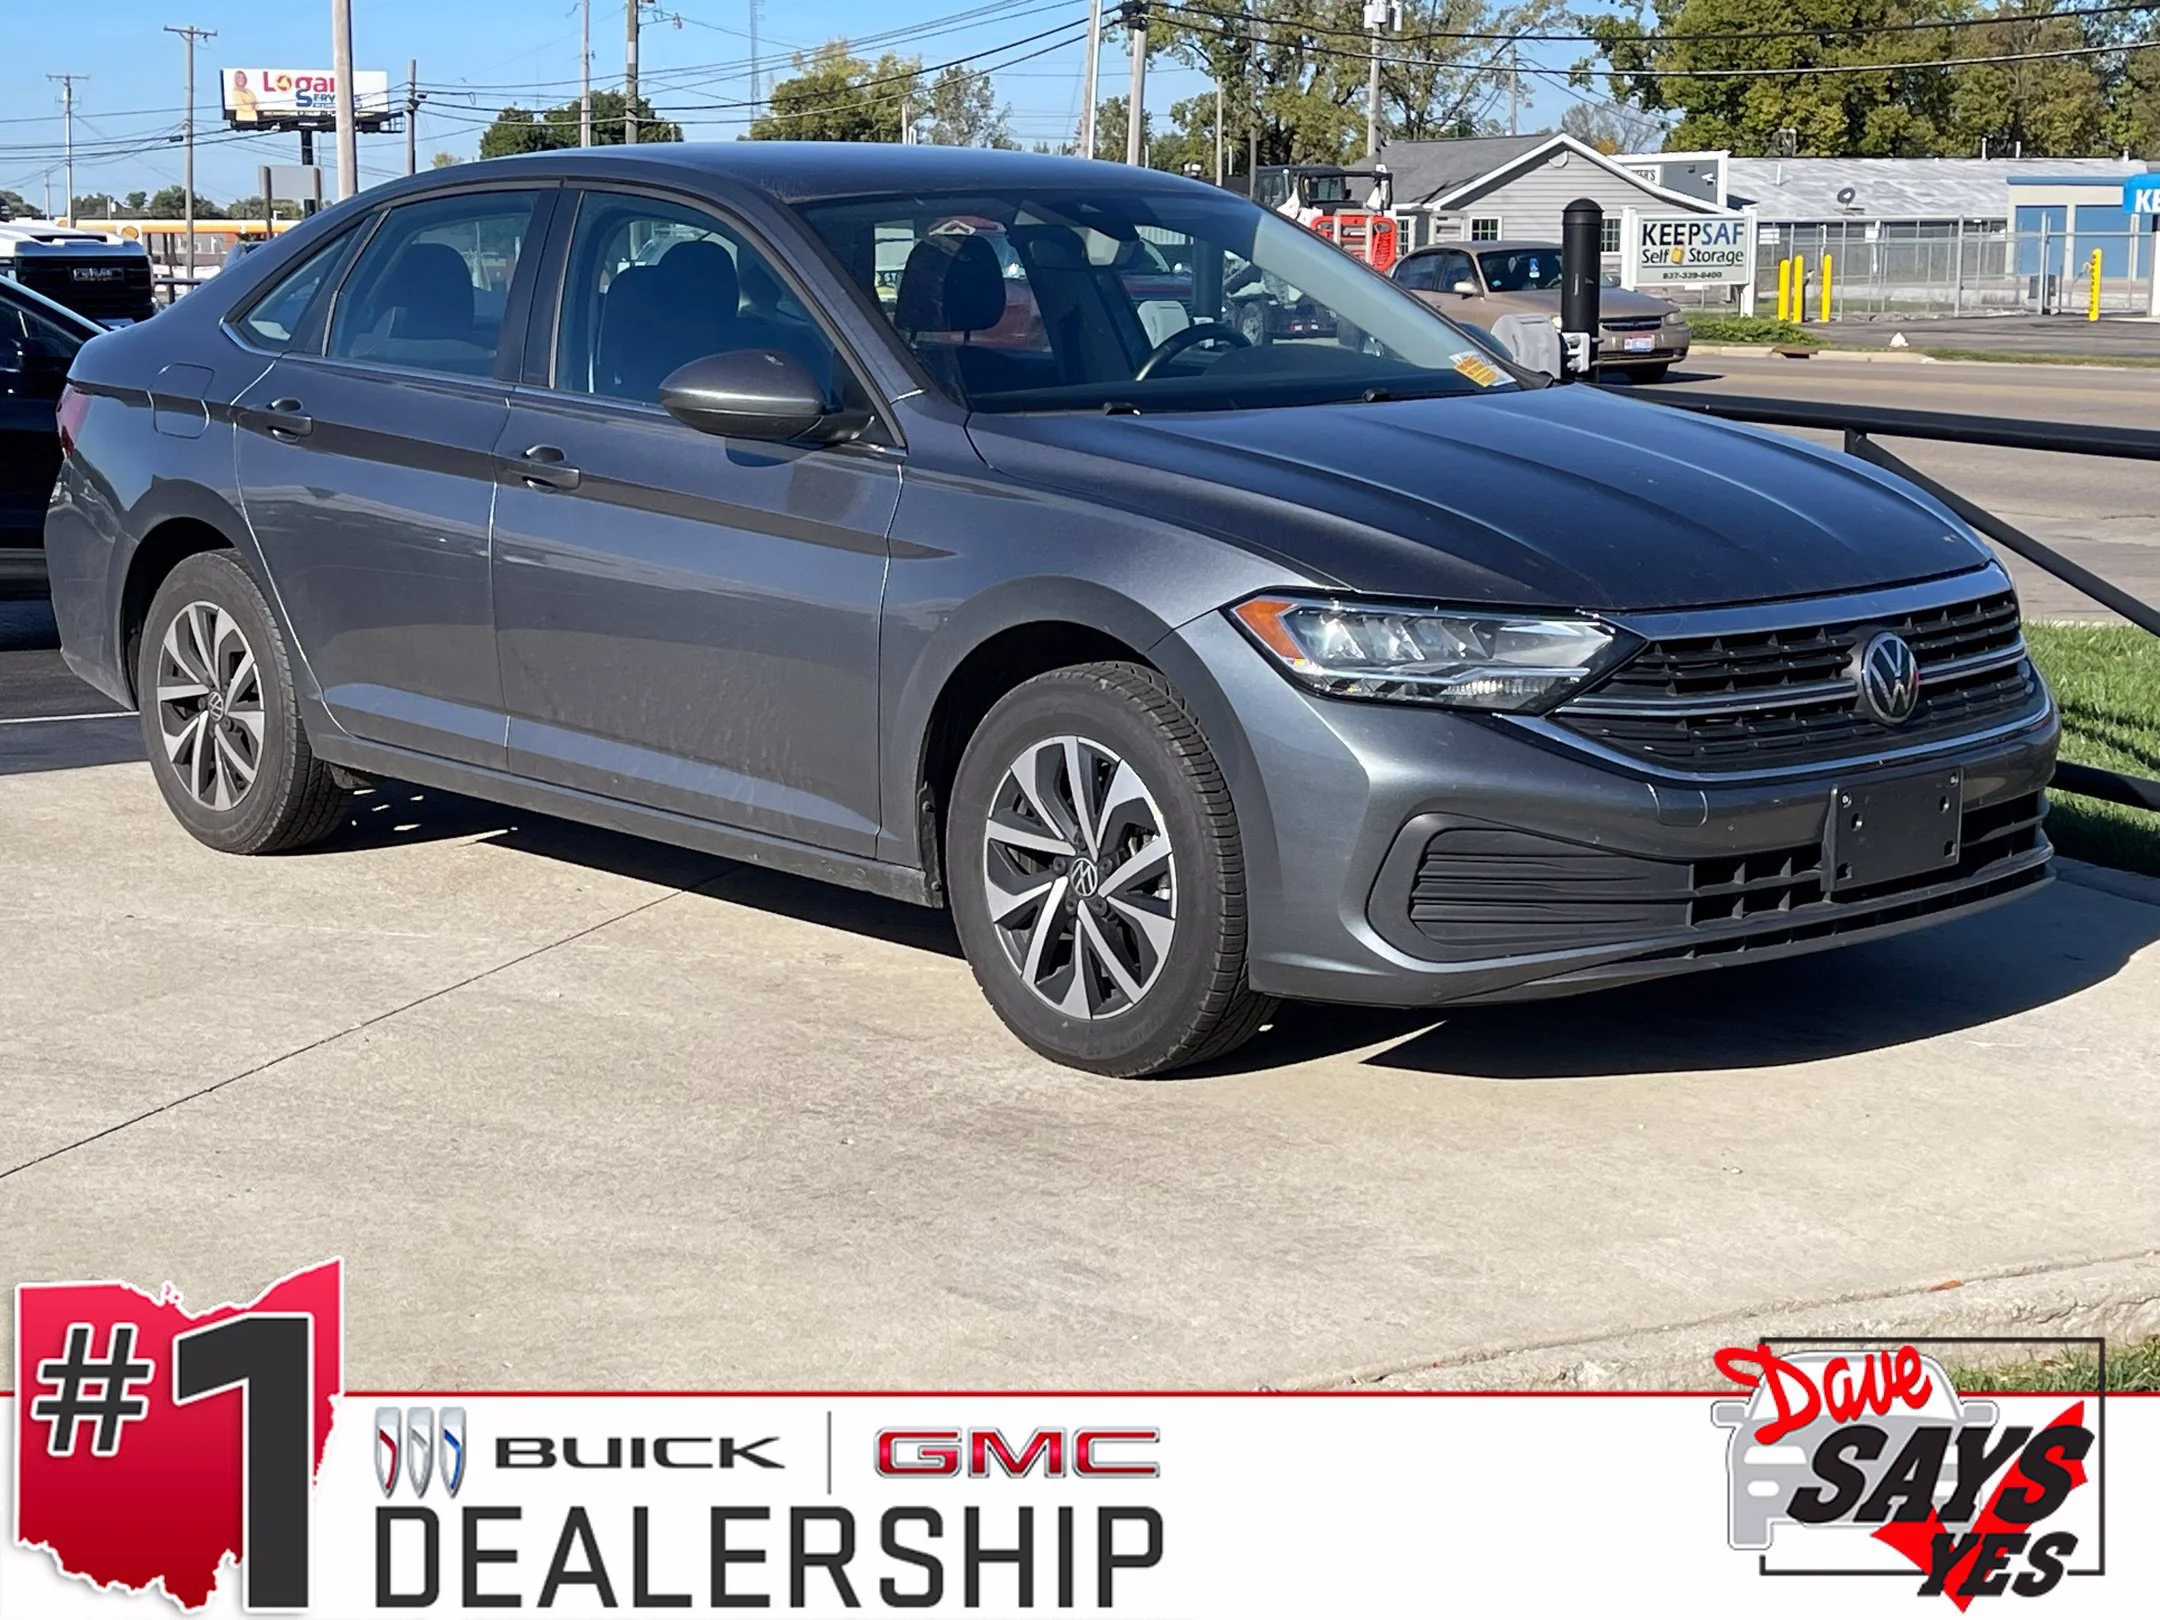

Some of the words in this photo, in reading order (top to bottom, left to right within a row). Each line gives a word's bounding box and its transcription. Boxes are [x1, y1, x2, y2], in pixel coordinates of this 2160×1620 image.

[1642, 222, 1745, 246] KEEPSAF
[1642, 248, 1670, 264] Self
[1688, 247, 1744, 267] Storage
